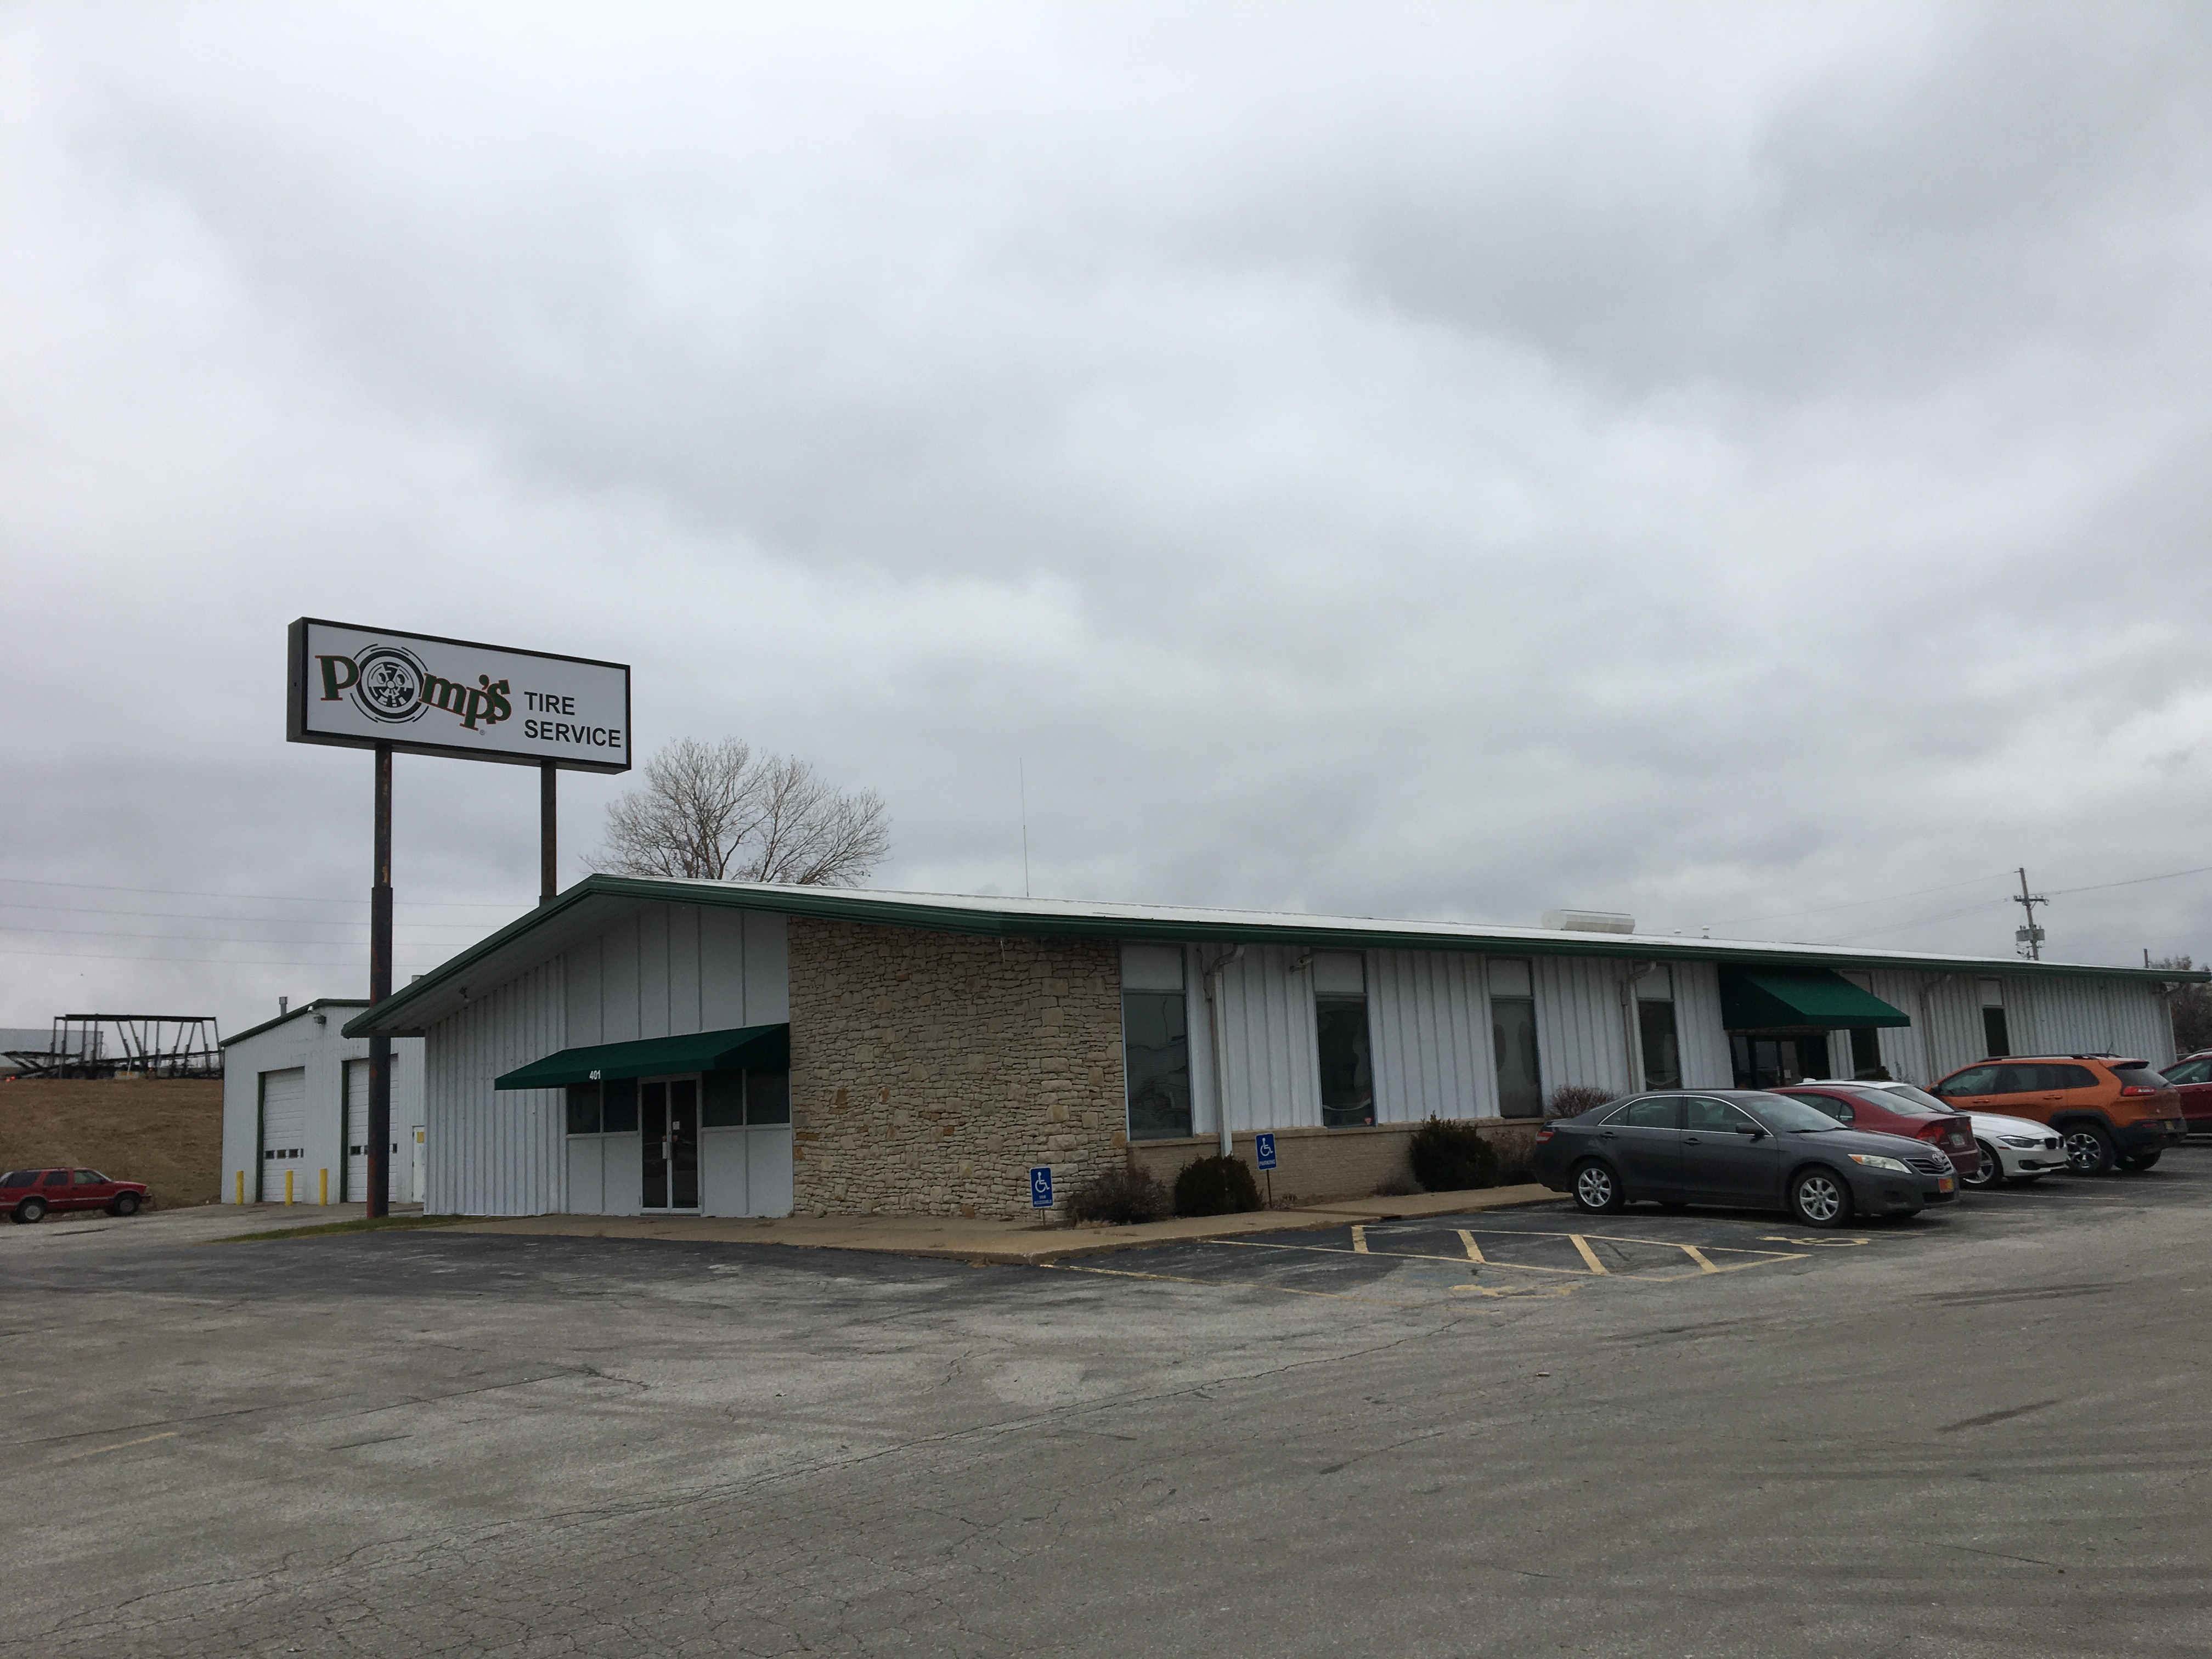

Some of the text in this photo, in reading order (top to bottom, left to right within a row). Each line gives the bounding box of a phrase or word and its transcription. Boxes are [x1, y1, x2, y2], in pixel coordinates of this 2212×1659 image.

[524, 691, 575, 715] TIRE
[524, 719, 621, 748] SERVICE
[589, 1070, 601, 1080] 401
